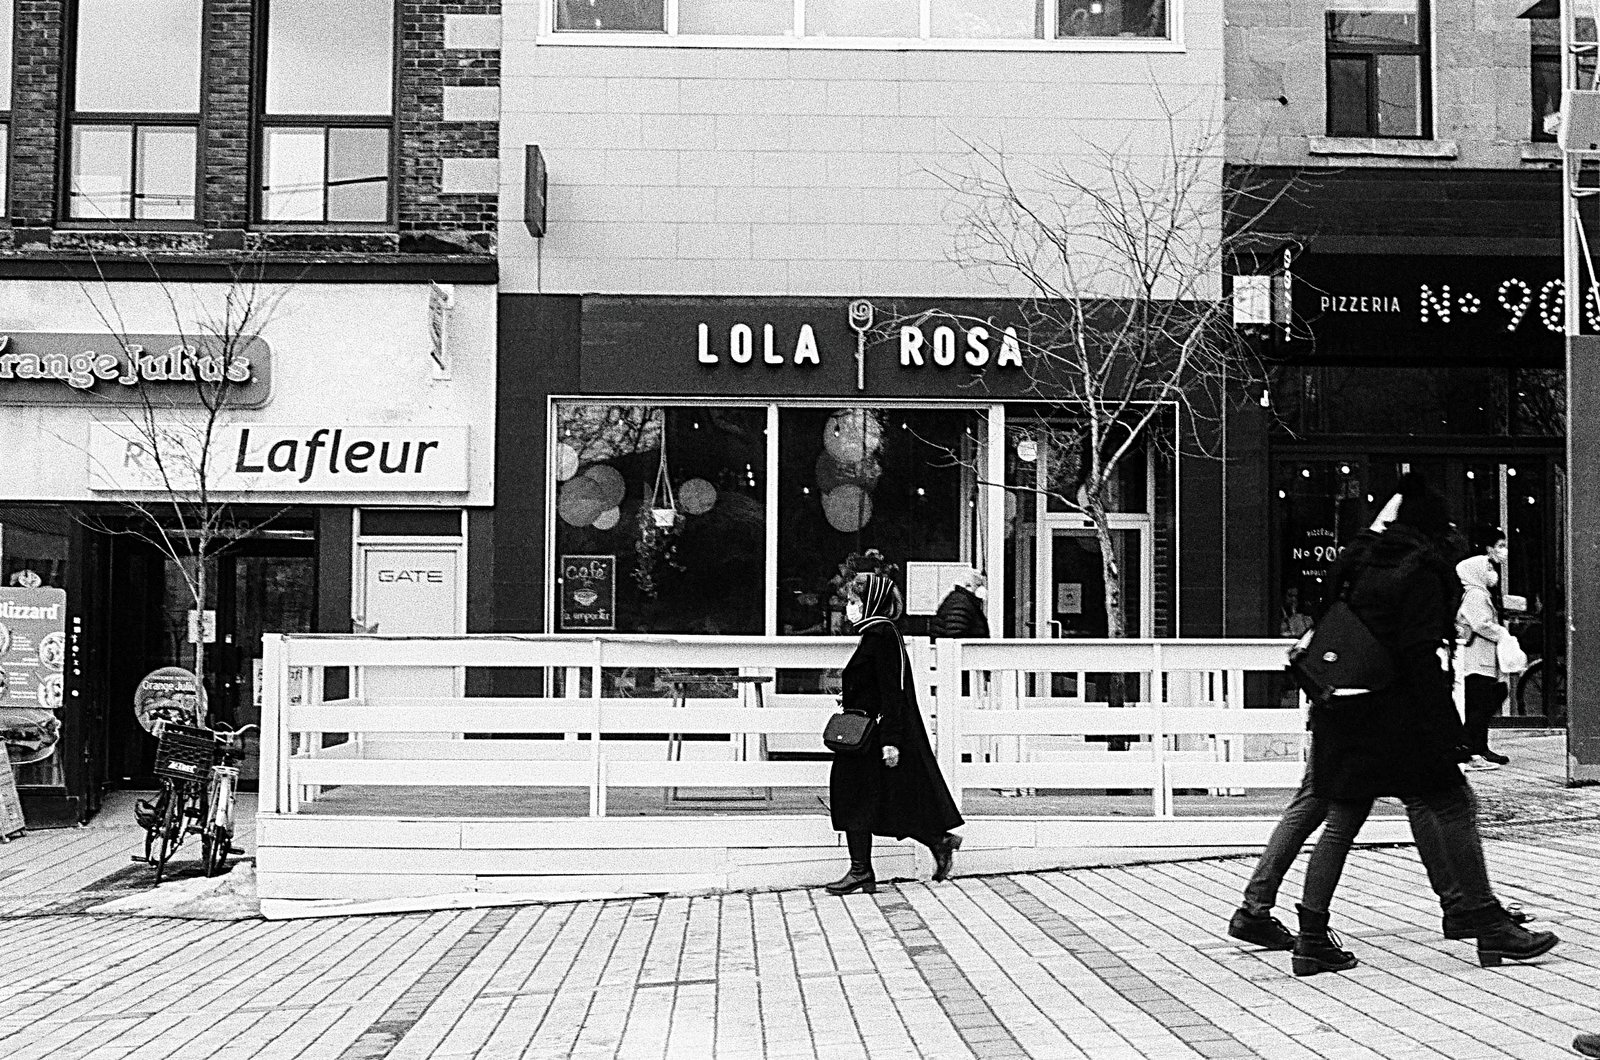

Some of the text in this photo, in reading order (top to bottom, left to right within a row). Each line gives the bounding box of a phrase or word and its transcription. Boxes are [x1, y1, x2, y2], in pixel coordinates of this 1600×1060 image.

[1320, 296, 1401, 313] PIZZERIA
[698, 323, 1023, 367] LOLA ROSA
[0, 335, 119, 389] range
[235, 428, 439, 484] Lafleur
[378, 569, 443, 583] GATE
[0, 600, 61, 620] lizzard
